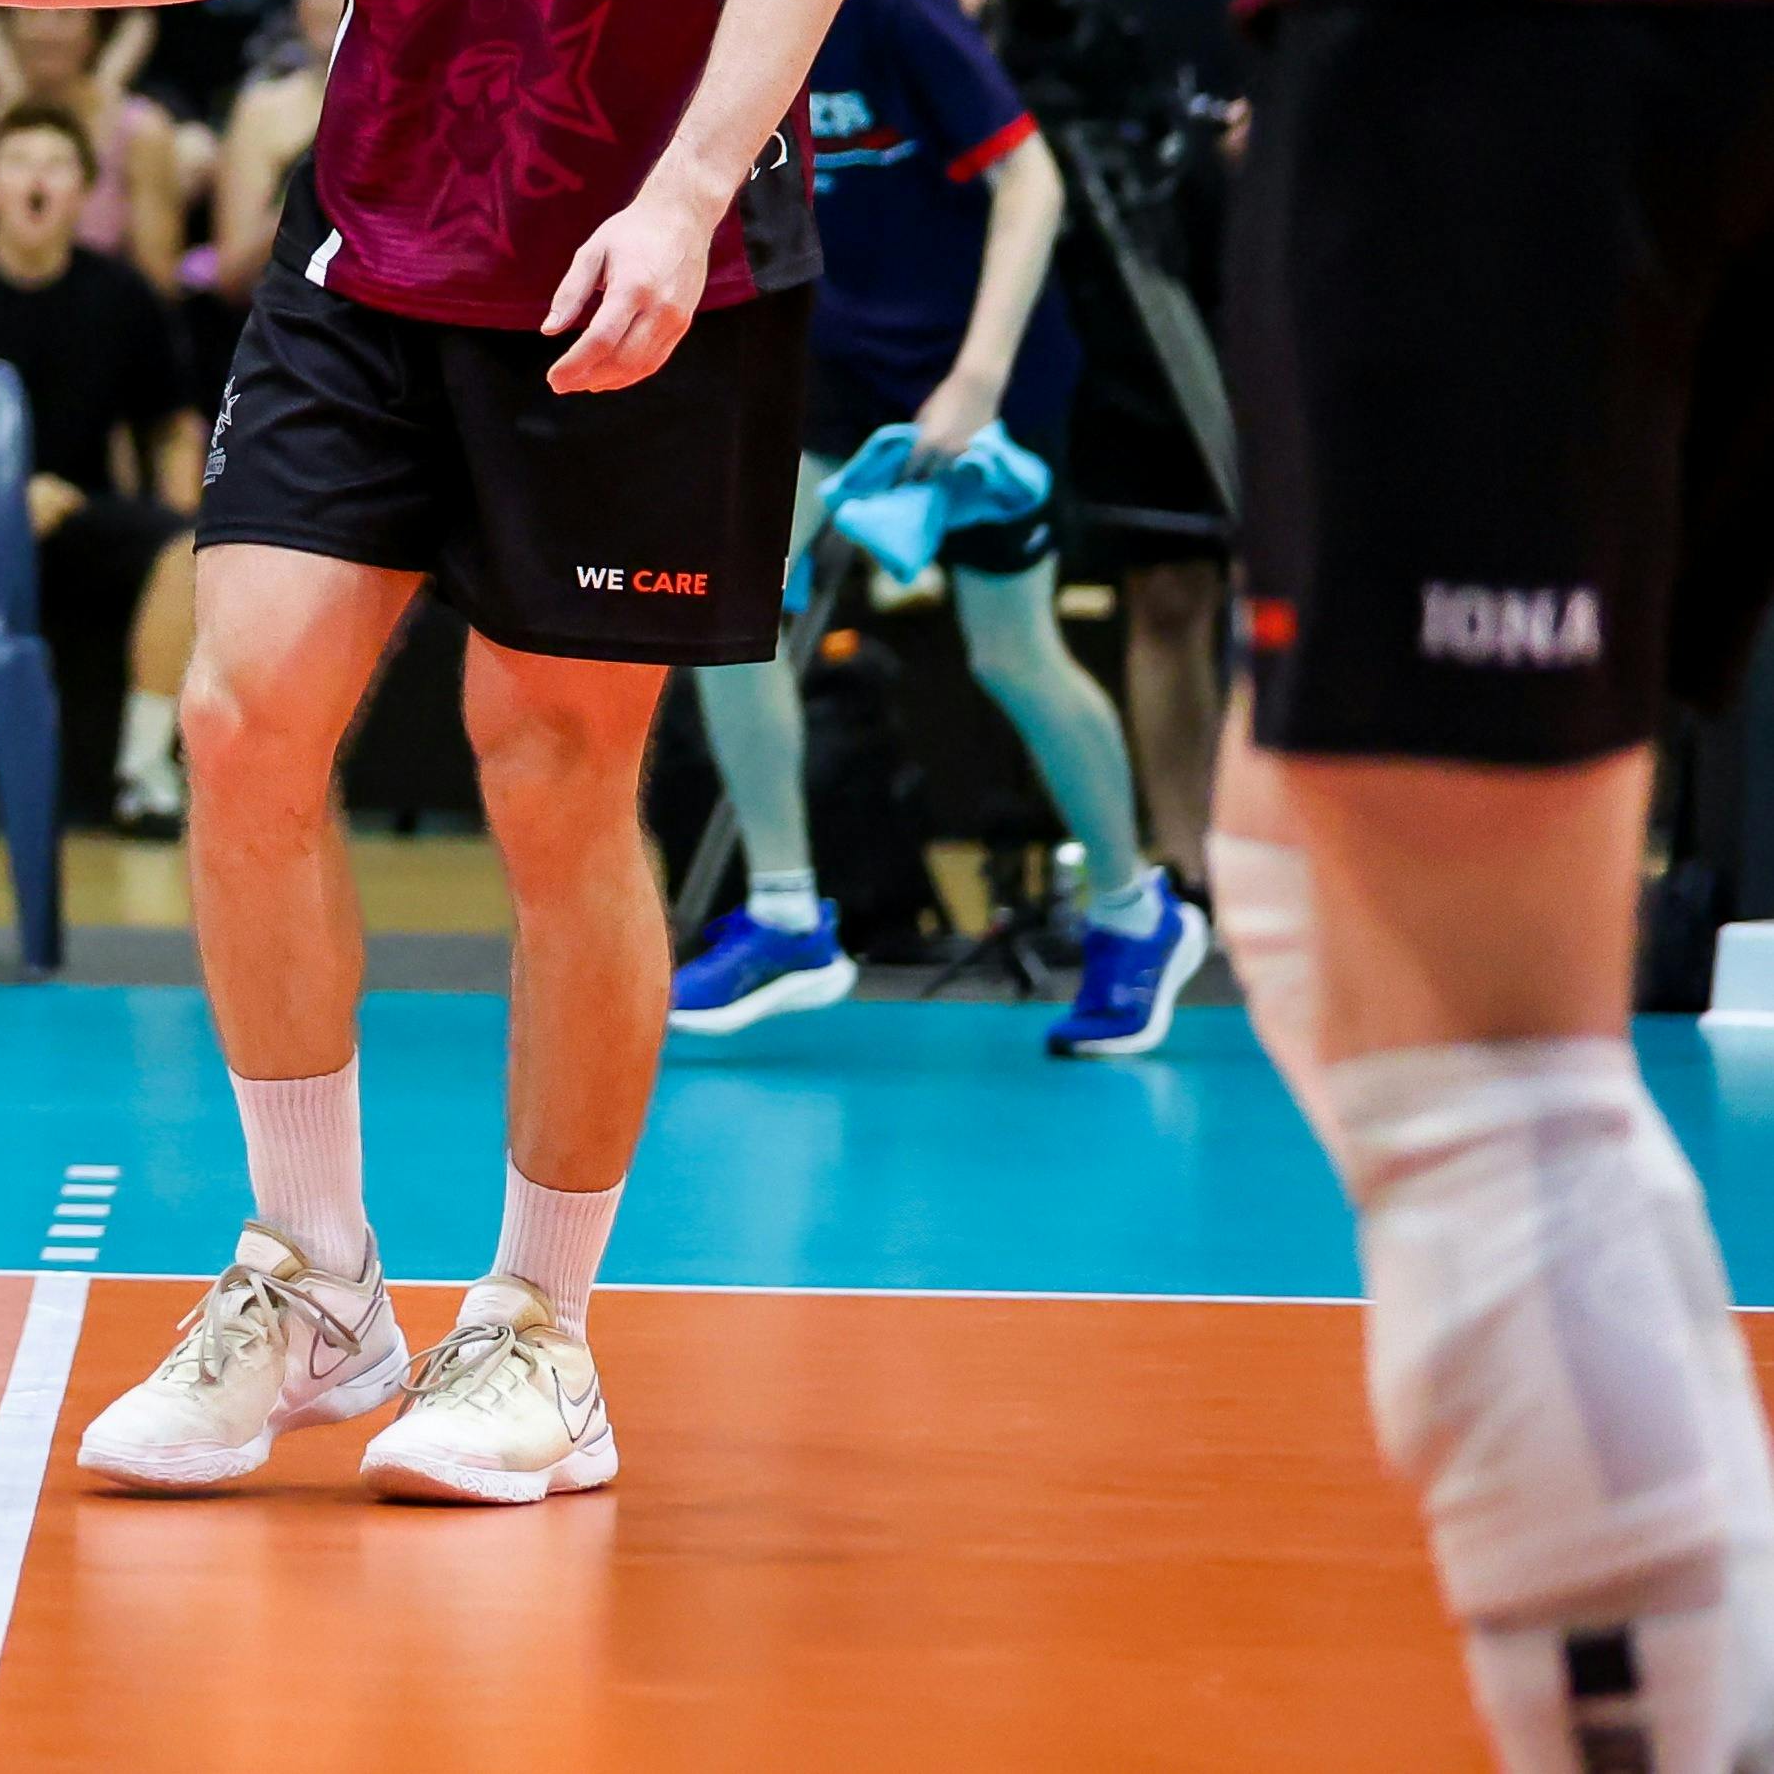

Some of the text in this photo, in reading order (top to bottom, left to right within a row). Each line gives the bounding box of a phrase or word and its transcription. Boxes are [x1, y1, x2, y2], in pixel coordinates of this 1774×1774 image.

[576, 565, 708, 595] WE CARE
[1421, 583, 1602, 665] IONA
